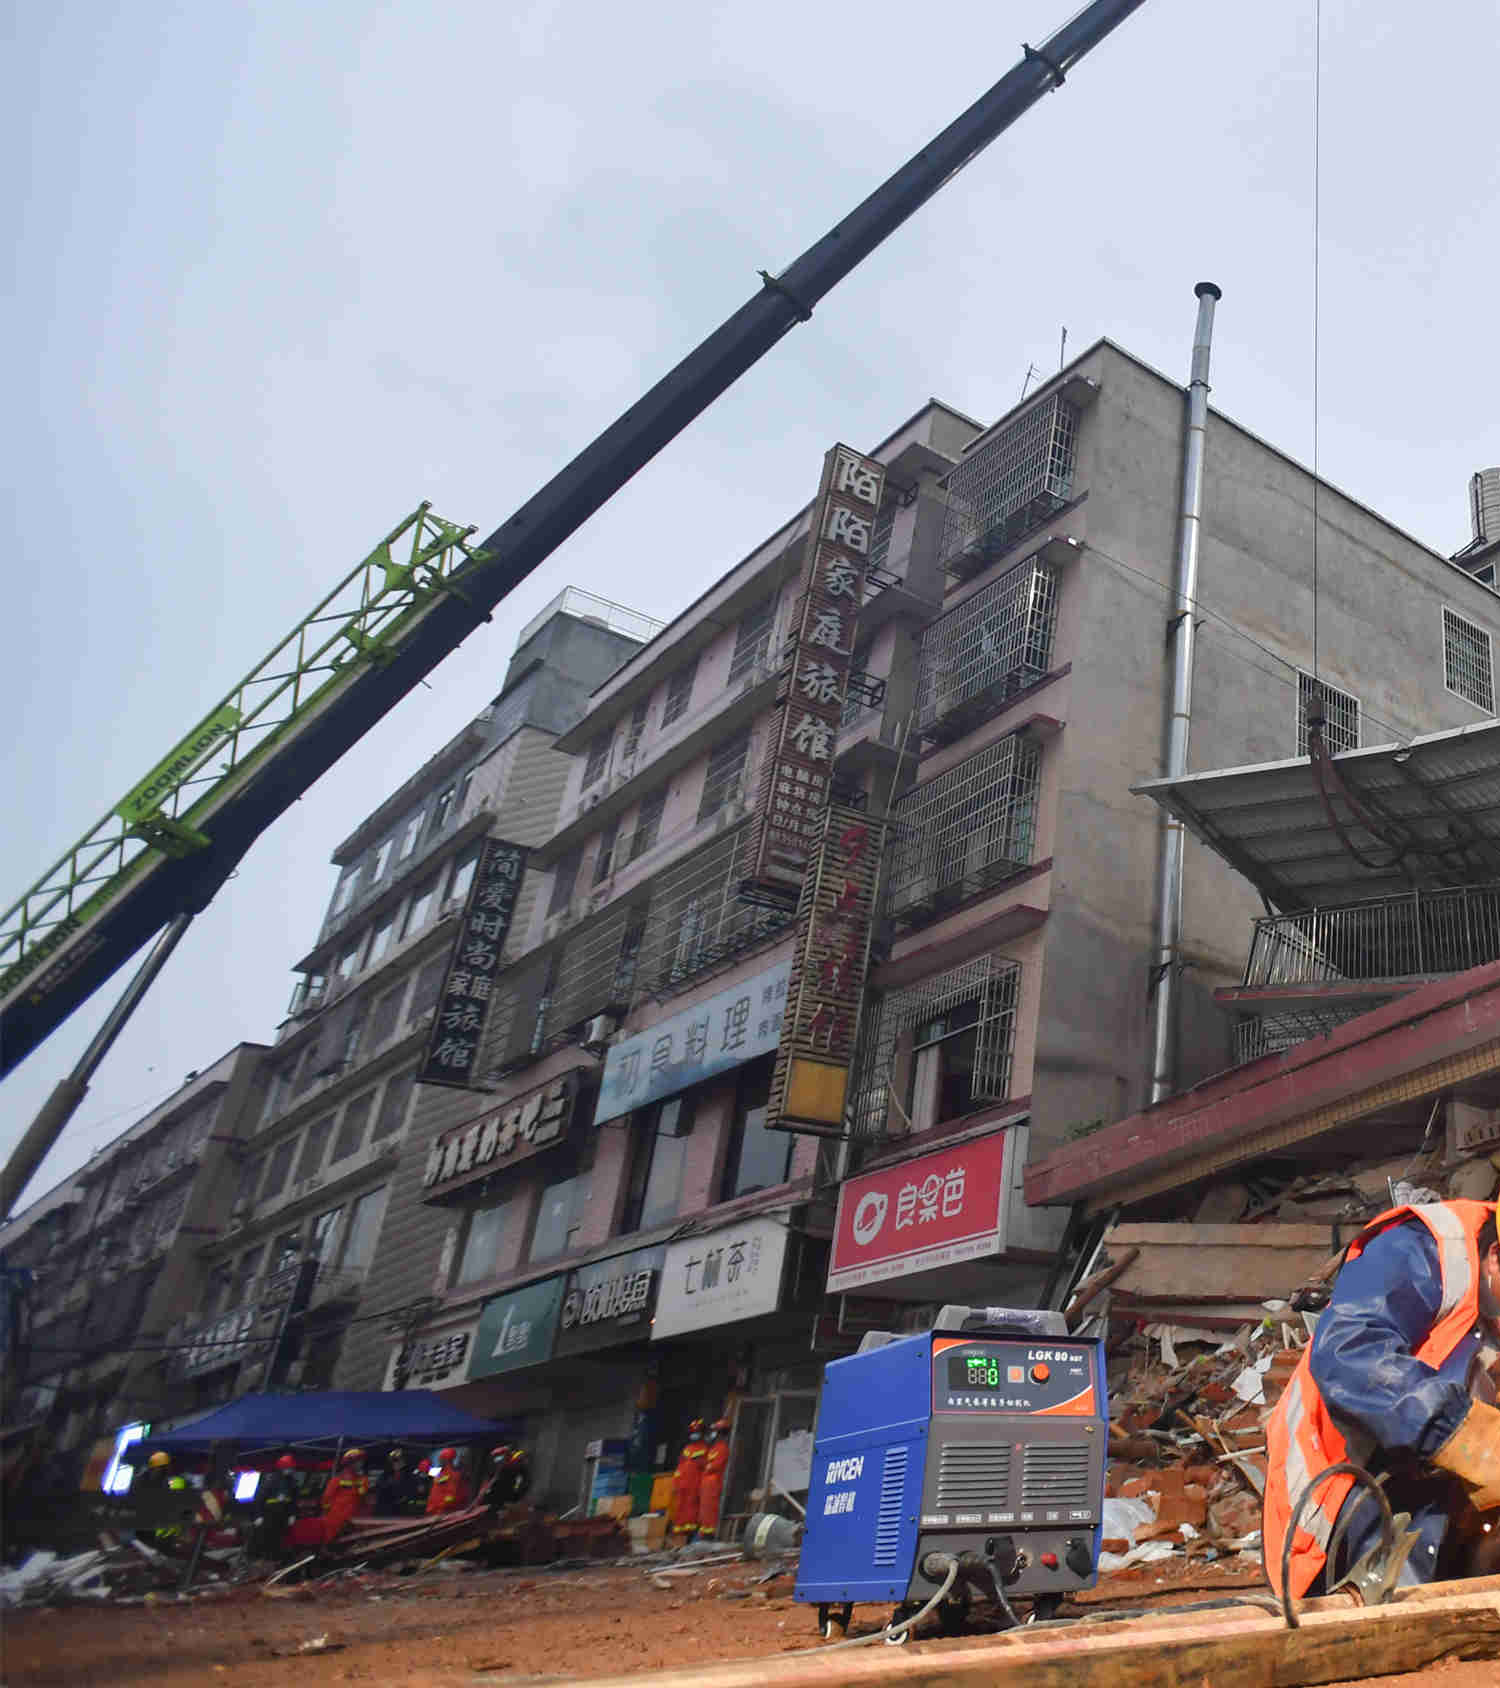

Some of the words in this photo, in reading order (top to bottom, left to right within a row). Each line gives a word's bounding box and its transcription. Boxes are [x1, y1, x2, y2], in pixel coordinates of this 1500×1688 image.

[791, 456, 880, 761] 陌陌家庭旅馆
[1028, 1350, 1053, 1361] LGK
[1054, 1351, 1068, 1362] 80
